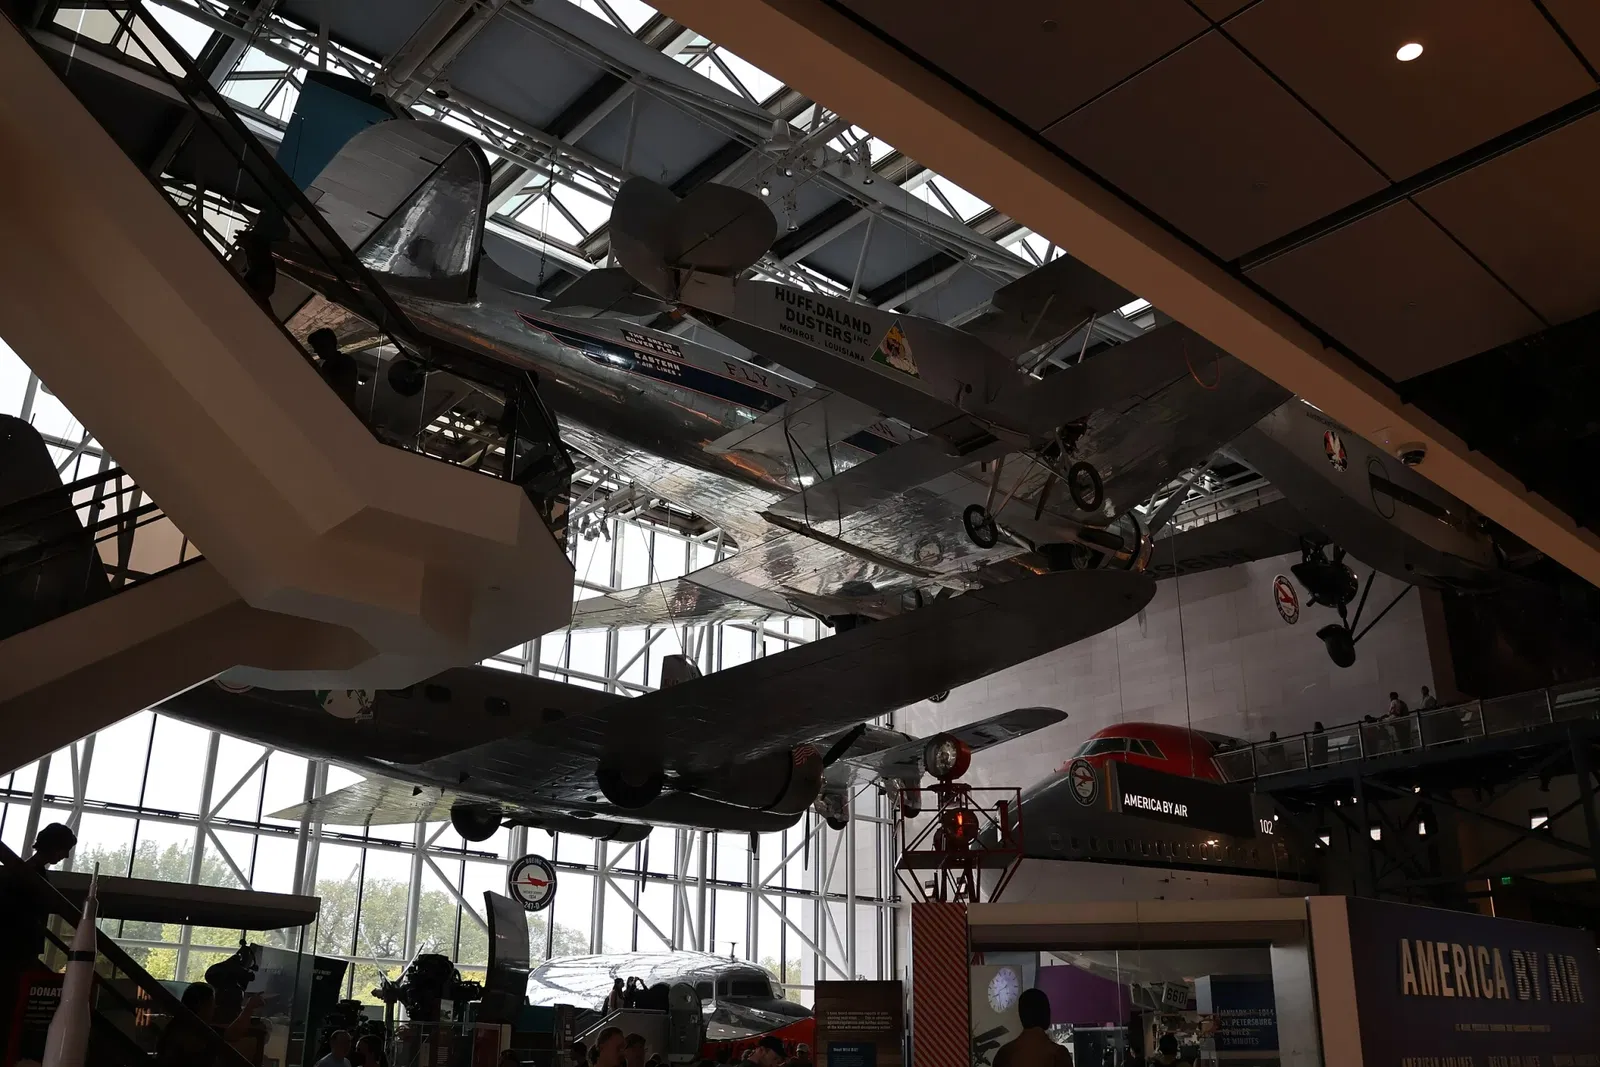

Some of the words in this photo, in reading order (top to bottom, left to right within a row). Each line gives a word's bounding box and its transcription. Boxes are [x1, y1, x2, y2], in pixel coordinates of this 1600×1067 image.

[785, 307, 852, 344] DUSTERS
[854, 334, 871, 346] INC.
[625, 336, 655, 349] SILVER
[656, 345, 682, 358] FLEET
[627, 332, 645, 341] THE
[647, 337, 673, 349] GREAT
[780, 323, 814, 342] MONROE
[824, 339, 866, 362] LOUISIANA
[633, 352, 681, 371] EASTERN
[723, 361, 768, 387] FLY
[1124, 793, 1162, 813] AMERICA
[1163, 800, 1175, 815] BY
[1174, 802, 1188, 818] AIR
[1259, 819, 1274, 835] 102
[1400, 938, 1510, 1000] AMERICA
[1511, 948, 1542, 1001] BY
[1545, 952, 1585, 1004] AIR
[29, 986, 63, 997] DONAT
[1232, 1018, 1273, 1027] PETERSBURG
[1232, 1037, 1260, 1045] MINUTES
